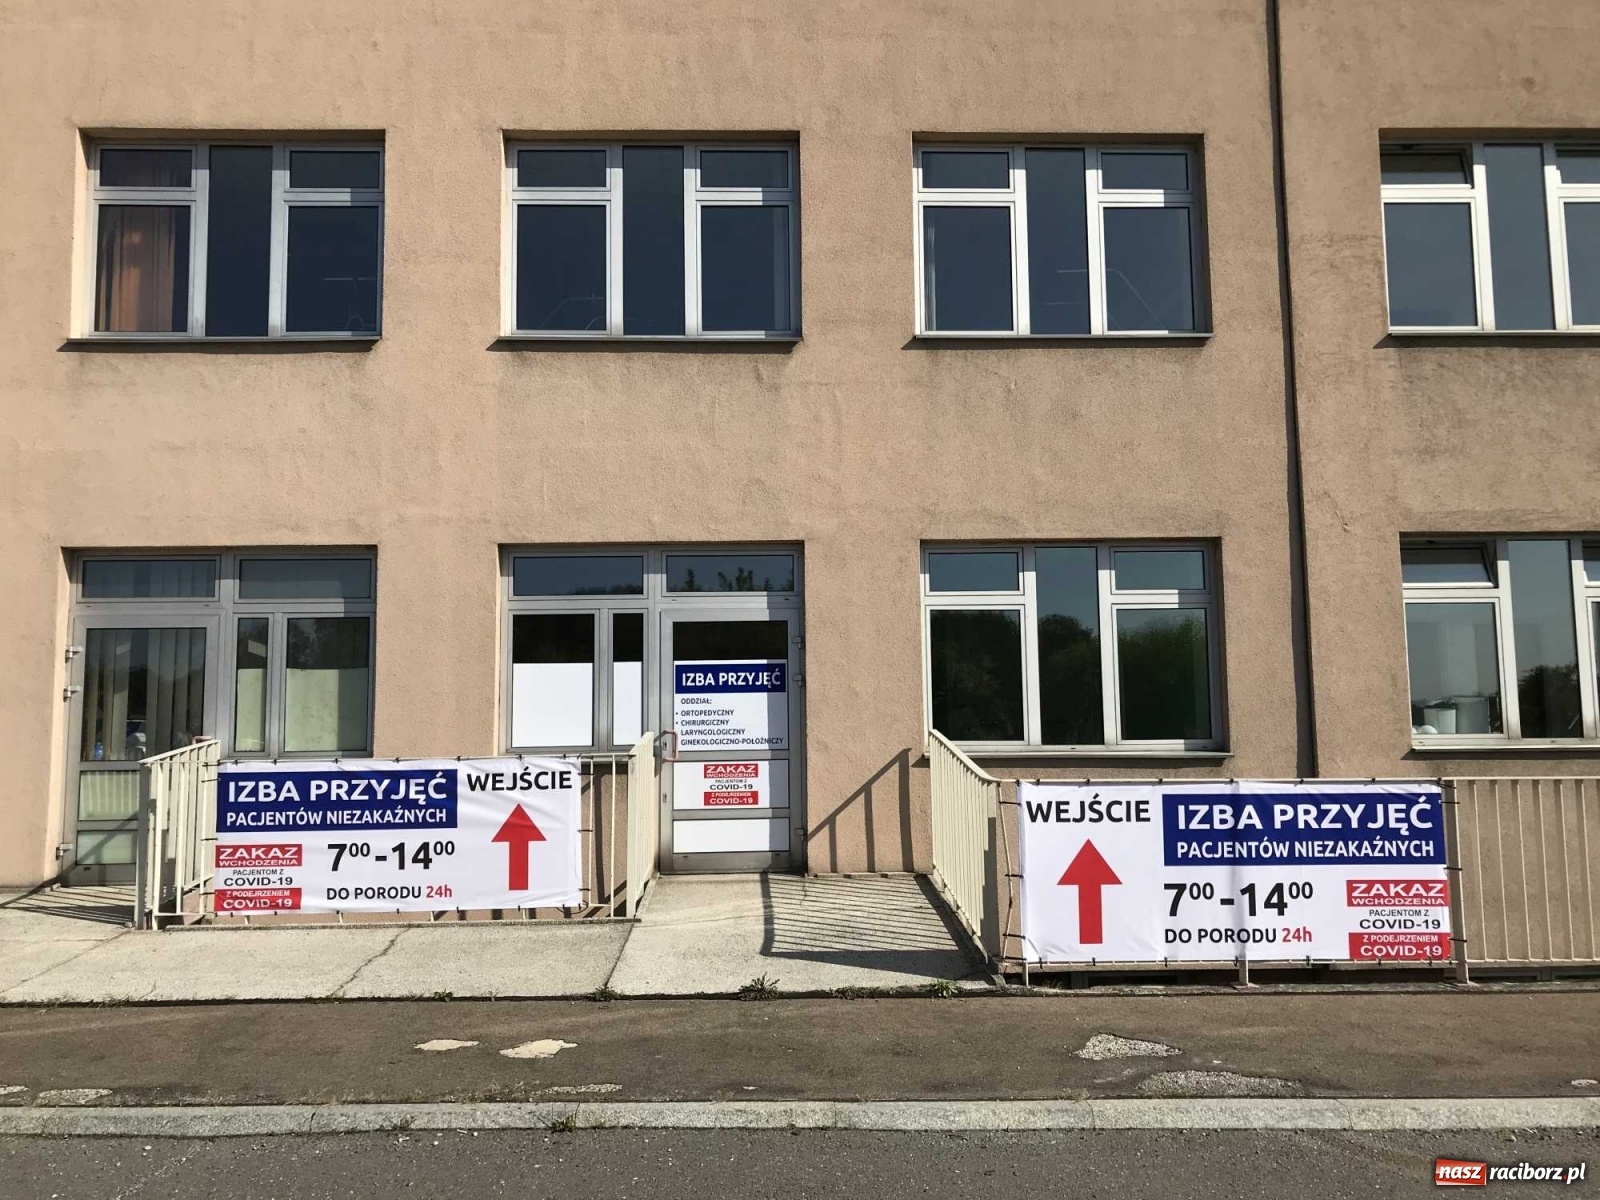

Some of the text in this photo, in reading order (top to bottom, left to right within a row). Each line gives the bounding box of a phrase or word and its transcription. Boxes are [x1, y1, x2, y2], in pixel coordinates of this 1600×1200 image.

[682, 668, 781, 688] IZBA PRZYJĘĆ
[681, 709, 735, 717] ORTOPEDYCZNY
[681, 728, 746, 736] LARYNGOLOGICZNY
[706, 765, 756, 773] ZAKAZ
[466, 765, 572, 792] WEJŚCIE
[228, 772, 448, 805] IZBA PRZYJĘĆ
[1026, 793, 1151, 823] WEJŚCIE
[226, 805, 447, 827] PACJENTÓW NIEZAKAŹNYCH
[1177, 796, 1433, 835] IZBA PRZYJĘĆ
[219, 847, 299, 860] ZAKAZ
[1177, 835, 1434, 859] PACJENTÓW NIEZAKAŹNYCH
[224, 876, 293, 886] COVID-19
[326, 885, 452, 900] DO PORODU 24h
[1351, 883, 1445, 896] ZAKAZ
[223, 898, 292, 909] COVID-19
[1359, 919, 1441, 929] COVID-19
[1165, 926, 1312, 944] DO PORODU 24h
[1371, 934, 1438, 942] PODEJRZENIEM
[1360, 945, 1442, 956] COVID-19
